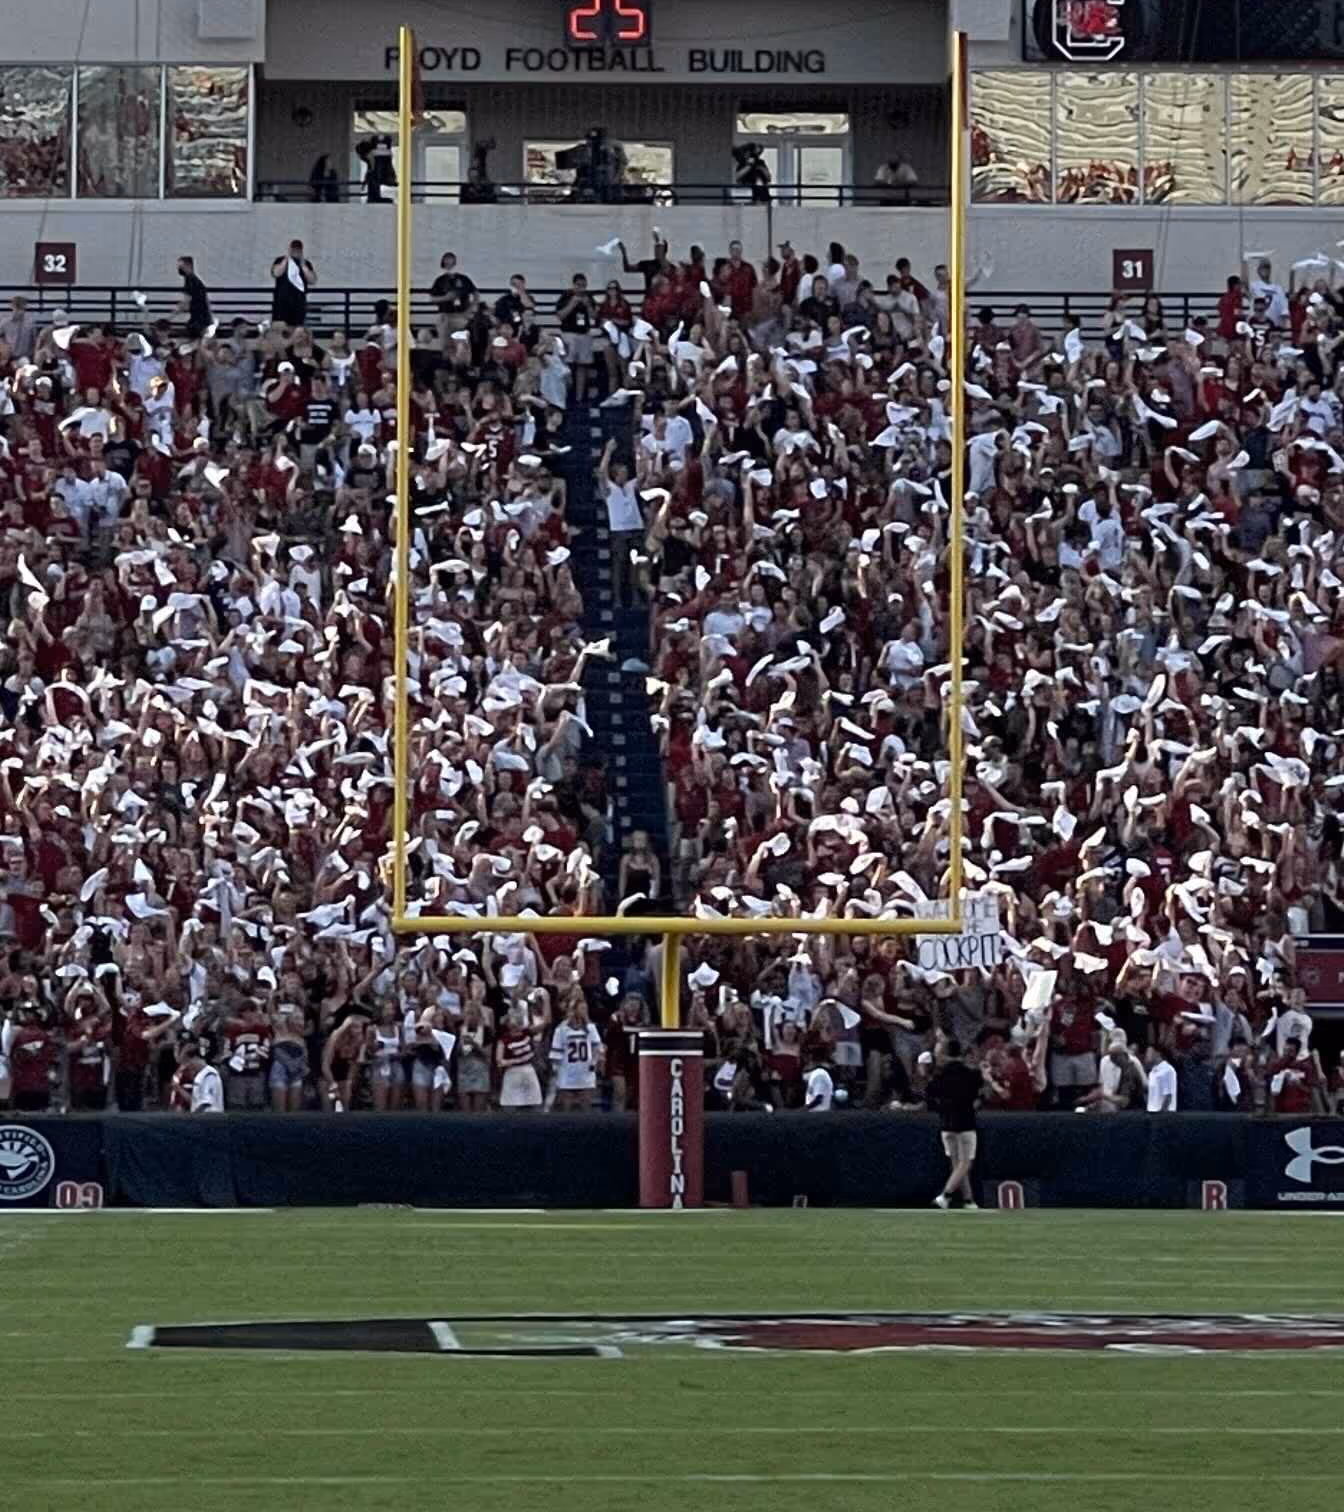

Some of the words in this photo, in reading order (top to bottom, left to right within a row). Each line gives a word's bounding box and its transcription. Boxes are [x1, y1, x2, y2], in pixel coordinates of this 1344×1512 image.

[384, 47, 482, 72] FOYD
[505, 47, 664, 73] FOOTBALL
[687, 48, 826, 75] BUILDING
[43, 254, 67, 273] 32
[1122, 258, 1144, 279] 31
[919, 932, 999, 971] COCKPIT
[567, 1041, 589, 1063] 20
[670, 1058, 685, 1209] CAROLINA
[1277, 1191, 1326, 1202] UNDER
